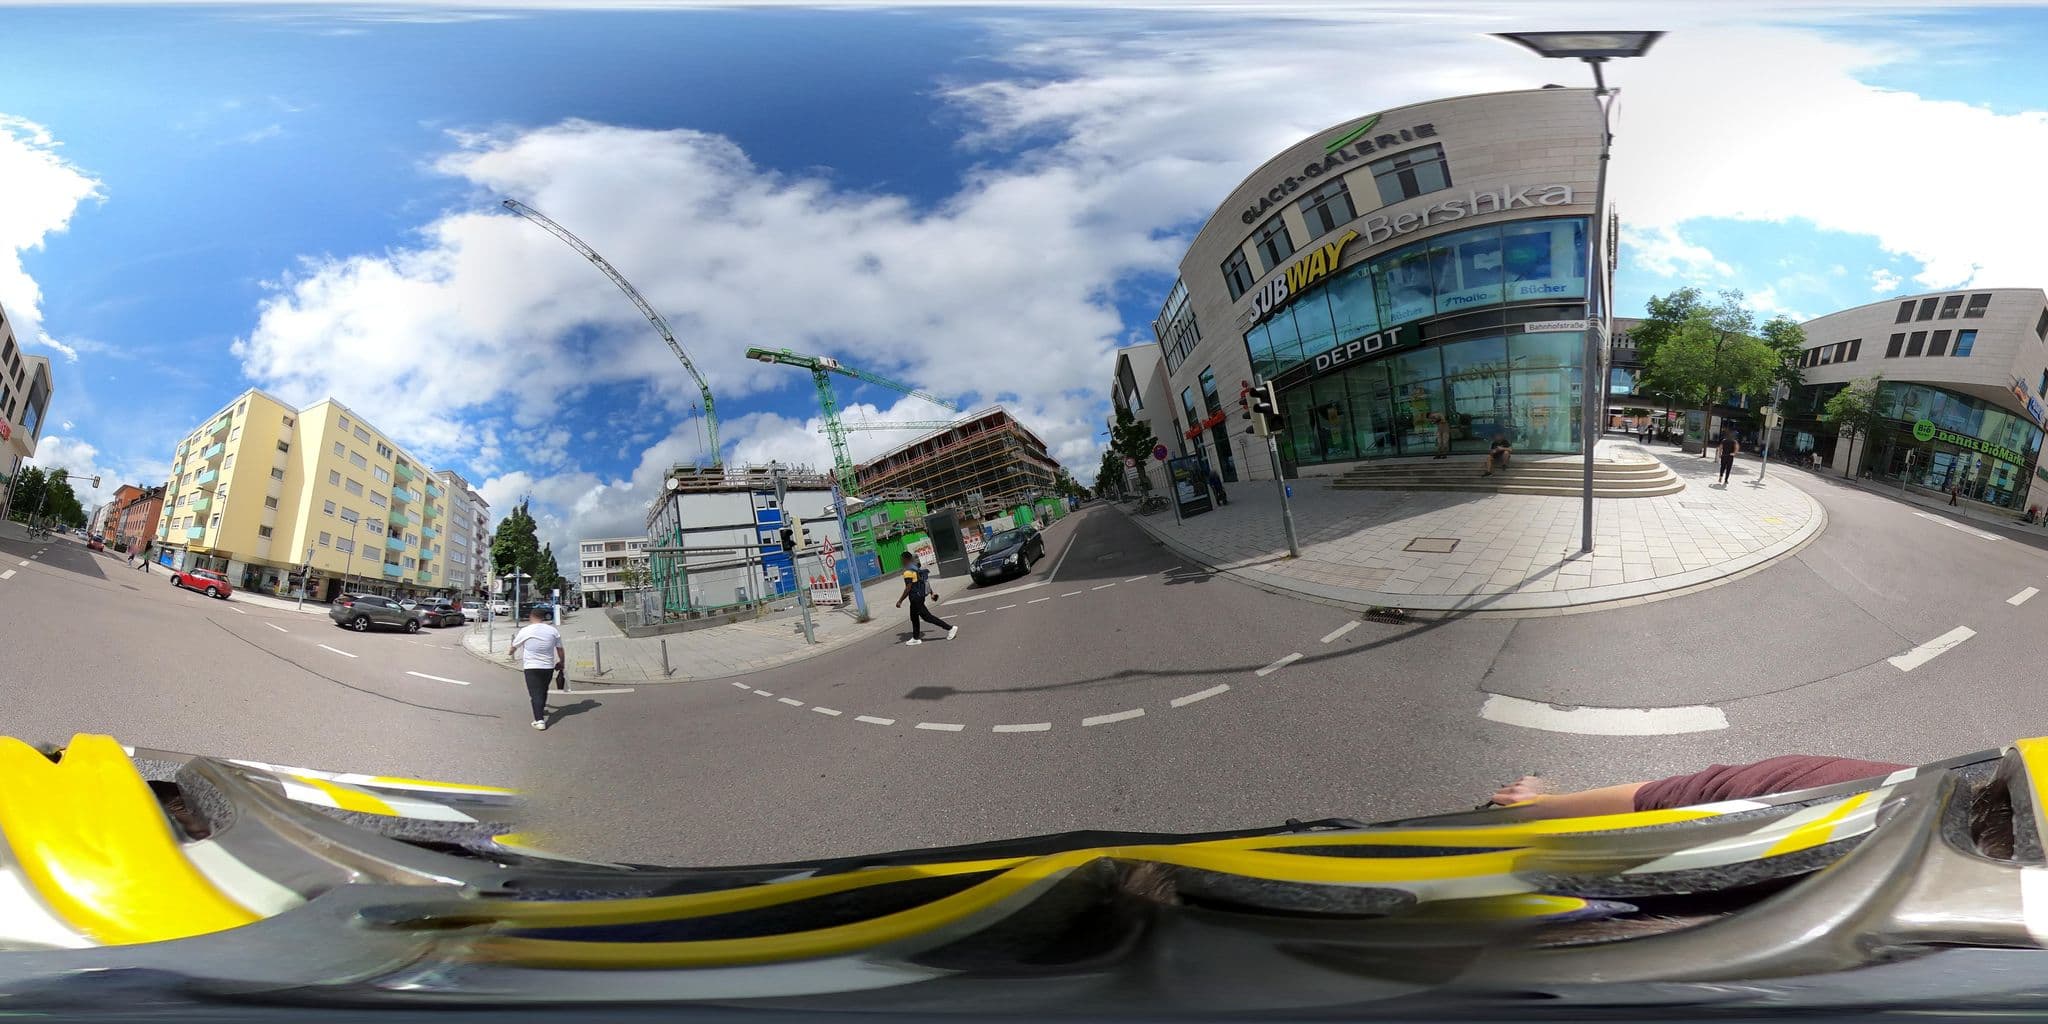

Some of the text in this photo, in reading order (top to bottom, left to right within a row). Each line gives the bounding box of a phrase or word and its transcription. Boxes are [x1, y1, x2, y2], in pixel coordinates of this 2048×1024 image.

[1362, 184, 1573, 247] Bershka
[1249, 231, 1359, 322] SUBWAY
[1520, 283, 1566, 295] Bücher
[1454, 292, 1487, 305] Thalia
[1530, 321, 1584, 331] Bahnhofstraße
[1315, 327, 1403, 371] DEPOT
